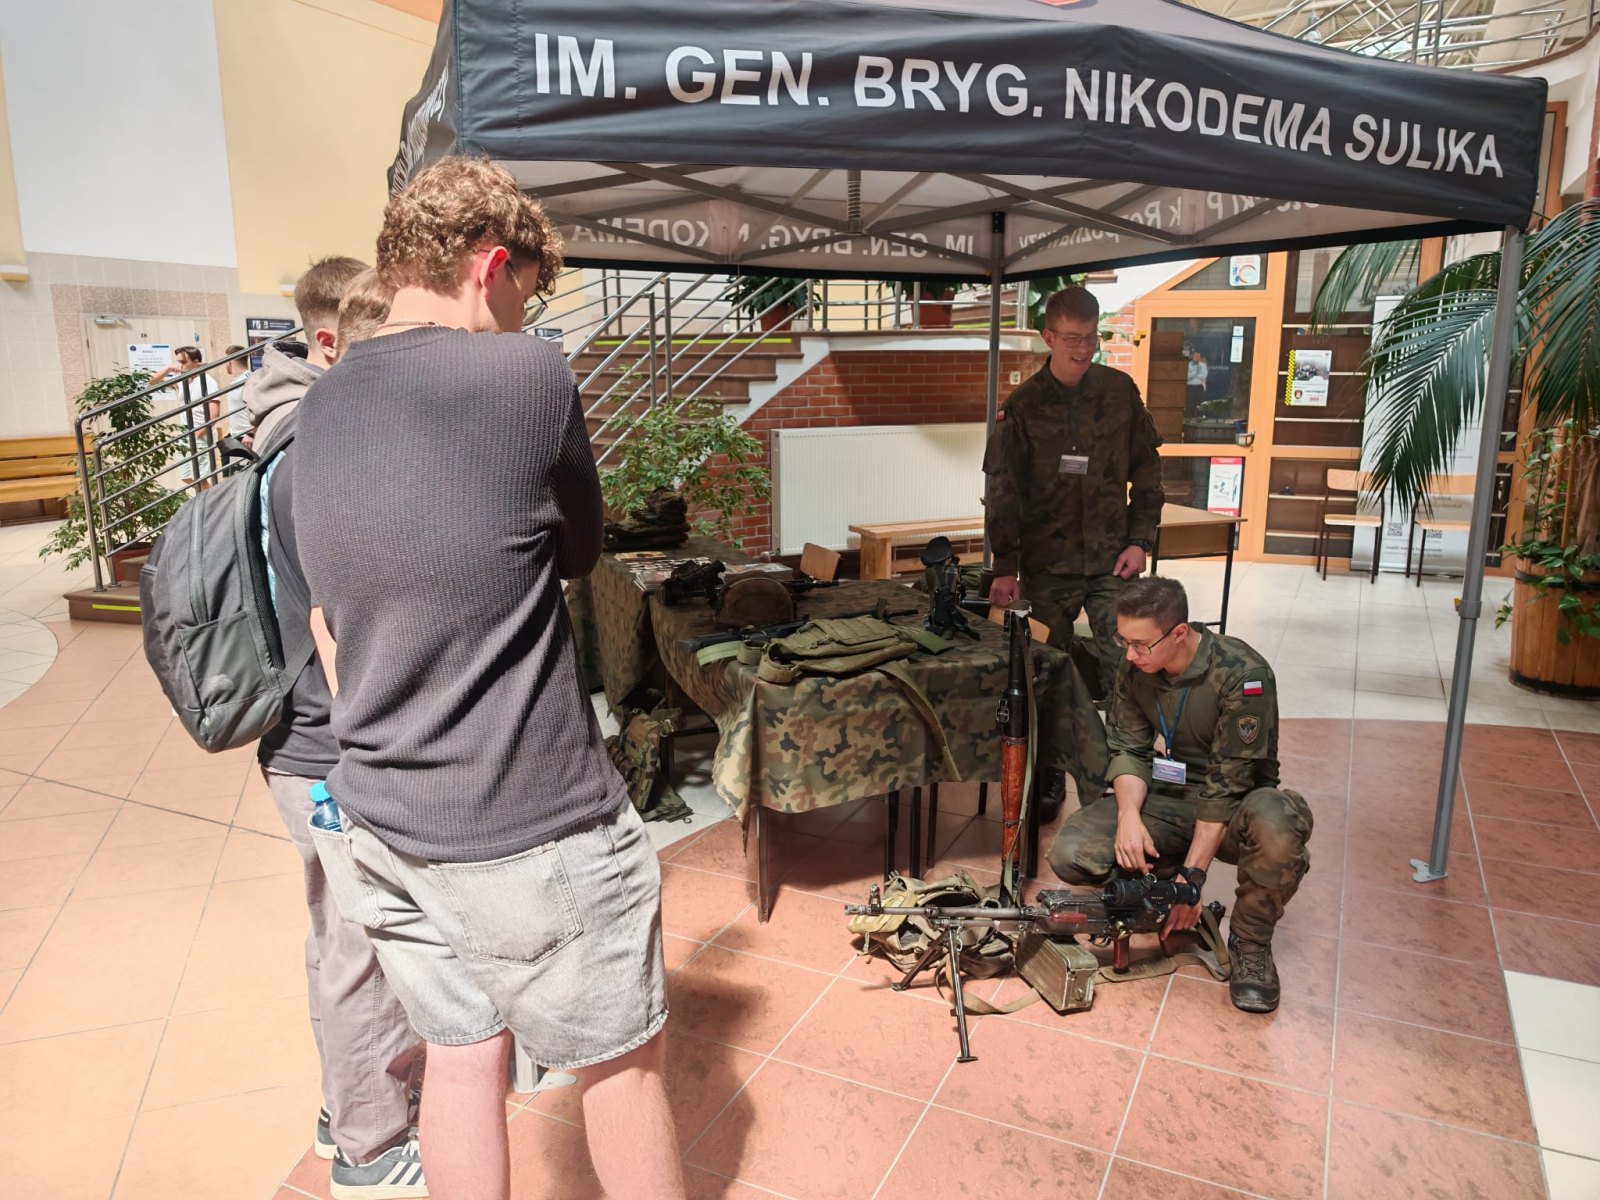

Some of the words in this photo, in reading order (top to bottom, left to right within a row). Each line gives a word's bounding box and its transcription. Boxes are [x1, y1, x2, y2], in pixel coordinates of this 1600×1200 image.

[534, 33, 637, 100] IM.
[665, 46, 829, 107] GEN.
[853, 55, 1043, 118] BRYG.
[1064, 67, 1332, 157] NIKODEMA
[1345, 113, 1504, 178] SULIKA
